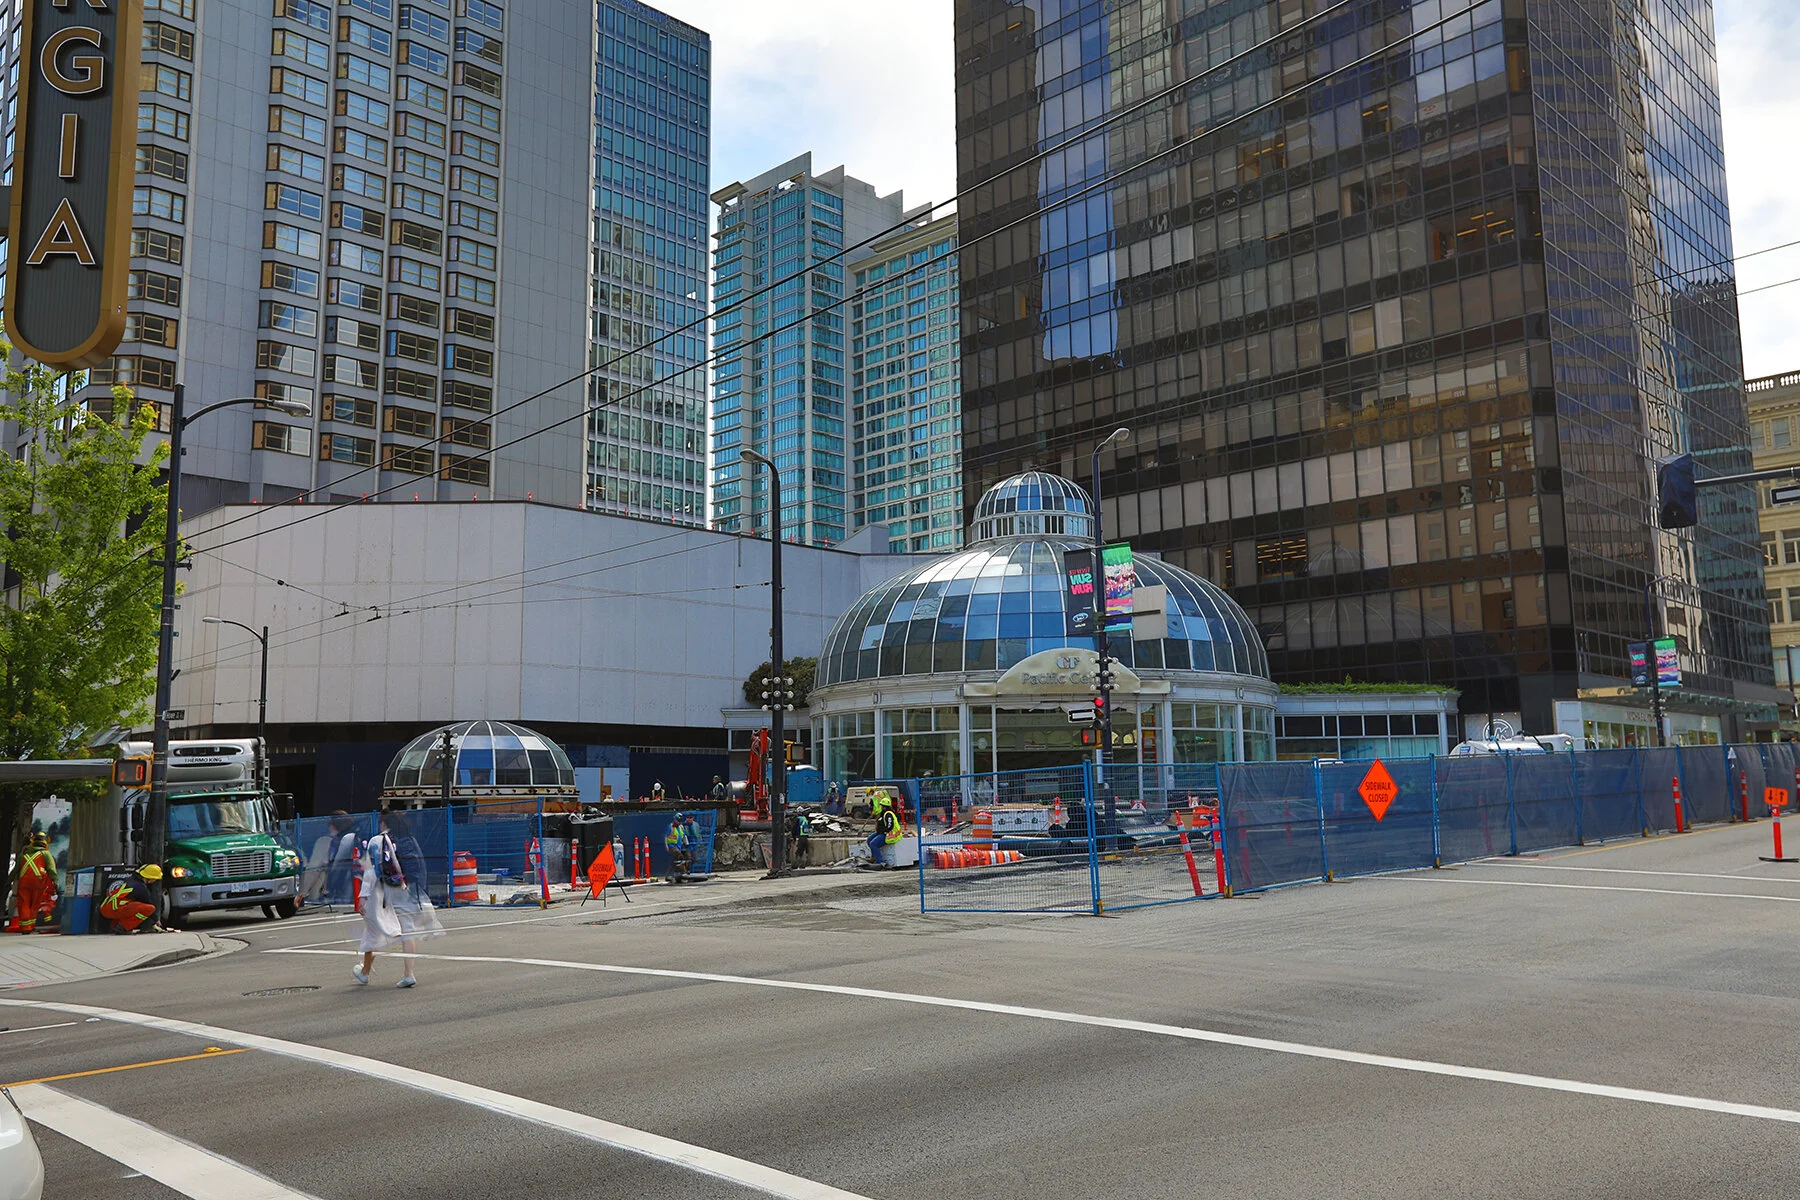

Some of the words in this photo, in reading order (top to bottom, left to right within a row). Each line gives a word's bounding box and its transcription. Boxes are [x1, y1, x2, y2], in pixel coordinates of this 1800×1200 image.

[1021, 672, 1066, 685] Pacific
[1365, 781, 1392, 791] SIDEWALK
[1368, 793, 1389, 803] CLOSED
